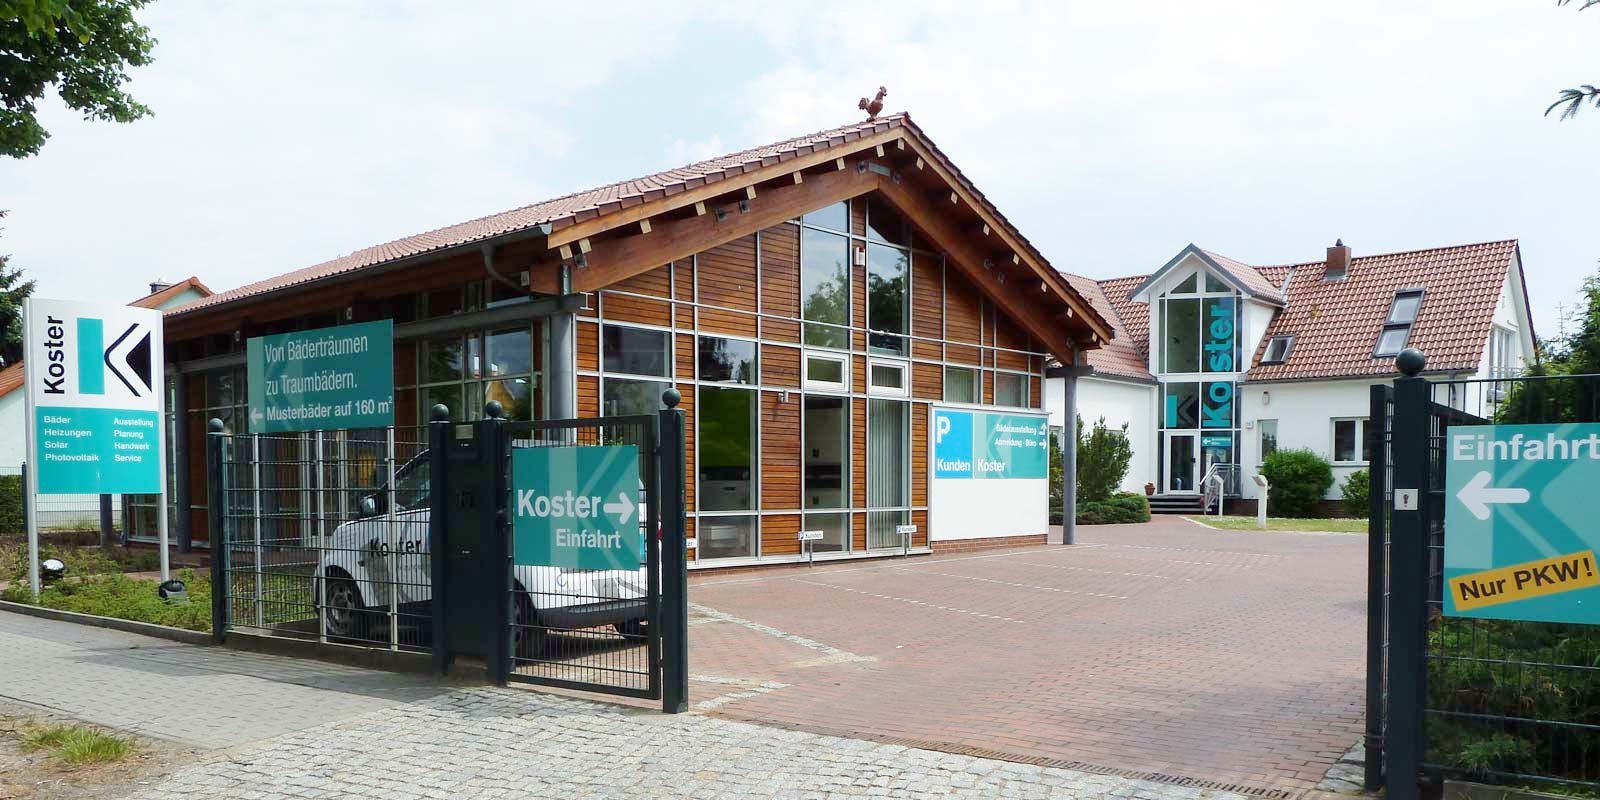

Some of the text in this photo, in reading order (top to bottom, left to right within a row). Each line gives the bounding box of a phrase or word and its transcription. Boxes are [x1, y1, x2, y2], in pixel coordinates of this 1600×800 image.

[43, 315, 65, 395] Koster
[265, 335, 368, 363] Von Bäderträumen
[1203, 305, 1234, 428] Koster
[266, 370, 358, 396] zu Traumbädern.
[43, 416, 71, 424] Bäder
[267, 403, 332, 421] Musterbäder
[334, 401, 352, 417] auf
[355, 399, 375, 415] 160
[113, 417, 154, 428] Ausstellung
[936, 416, 951, 444] P
[44, 428, 92, 438] Heizungen
[113, 429, 144, 439] Planung
[44, 441, 68, 449] Solar
[114, 442, 150, 450] Handwerk
[1453, 433, 1600, 461] Einfahrt
[45, 453, 100, 462] Photovoltaik
[114, 454, 142, 462] Service
[937, 458, 971, 472] Kunden
[977, 459, 1006, 472] Koster
[517, 489, 602, 518] Koster
[370, 537, 422, 557] Koter
[556, 528, 622, 549] Einfahrt
[1459, 558, 1593, 601] Nur PKW!
